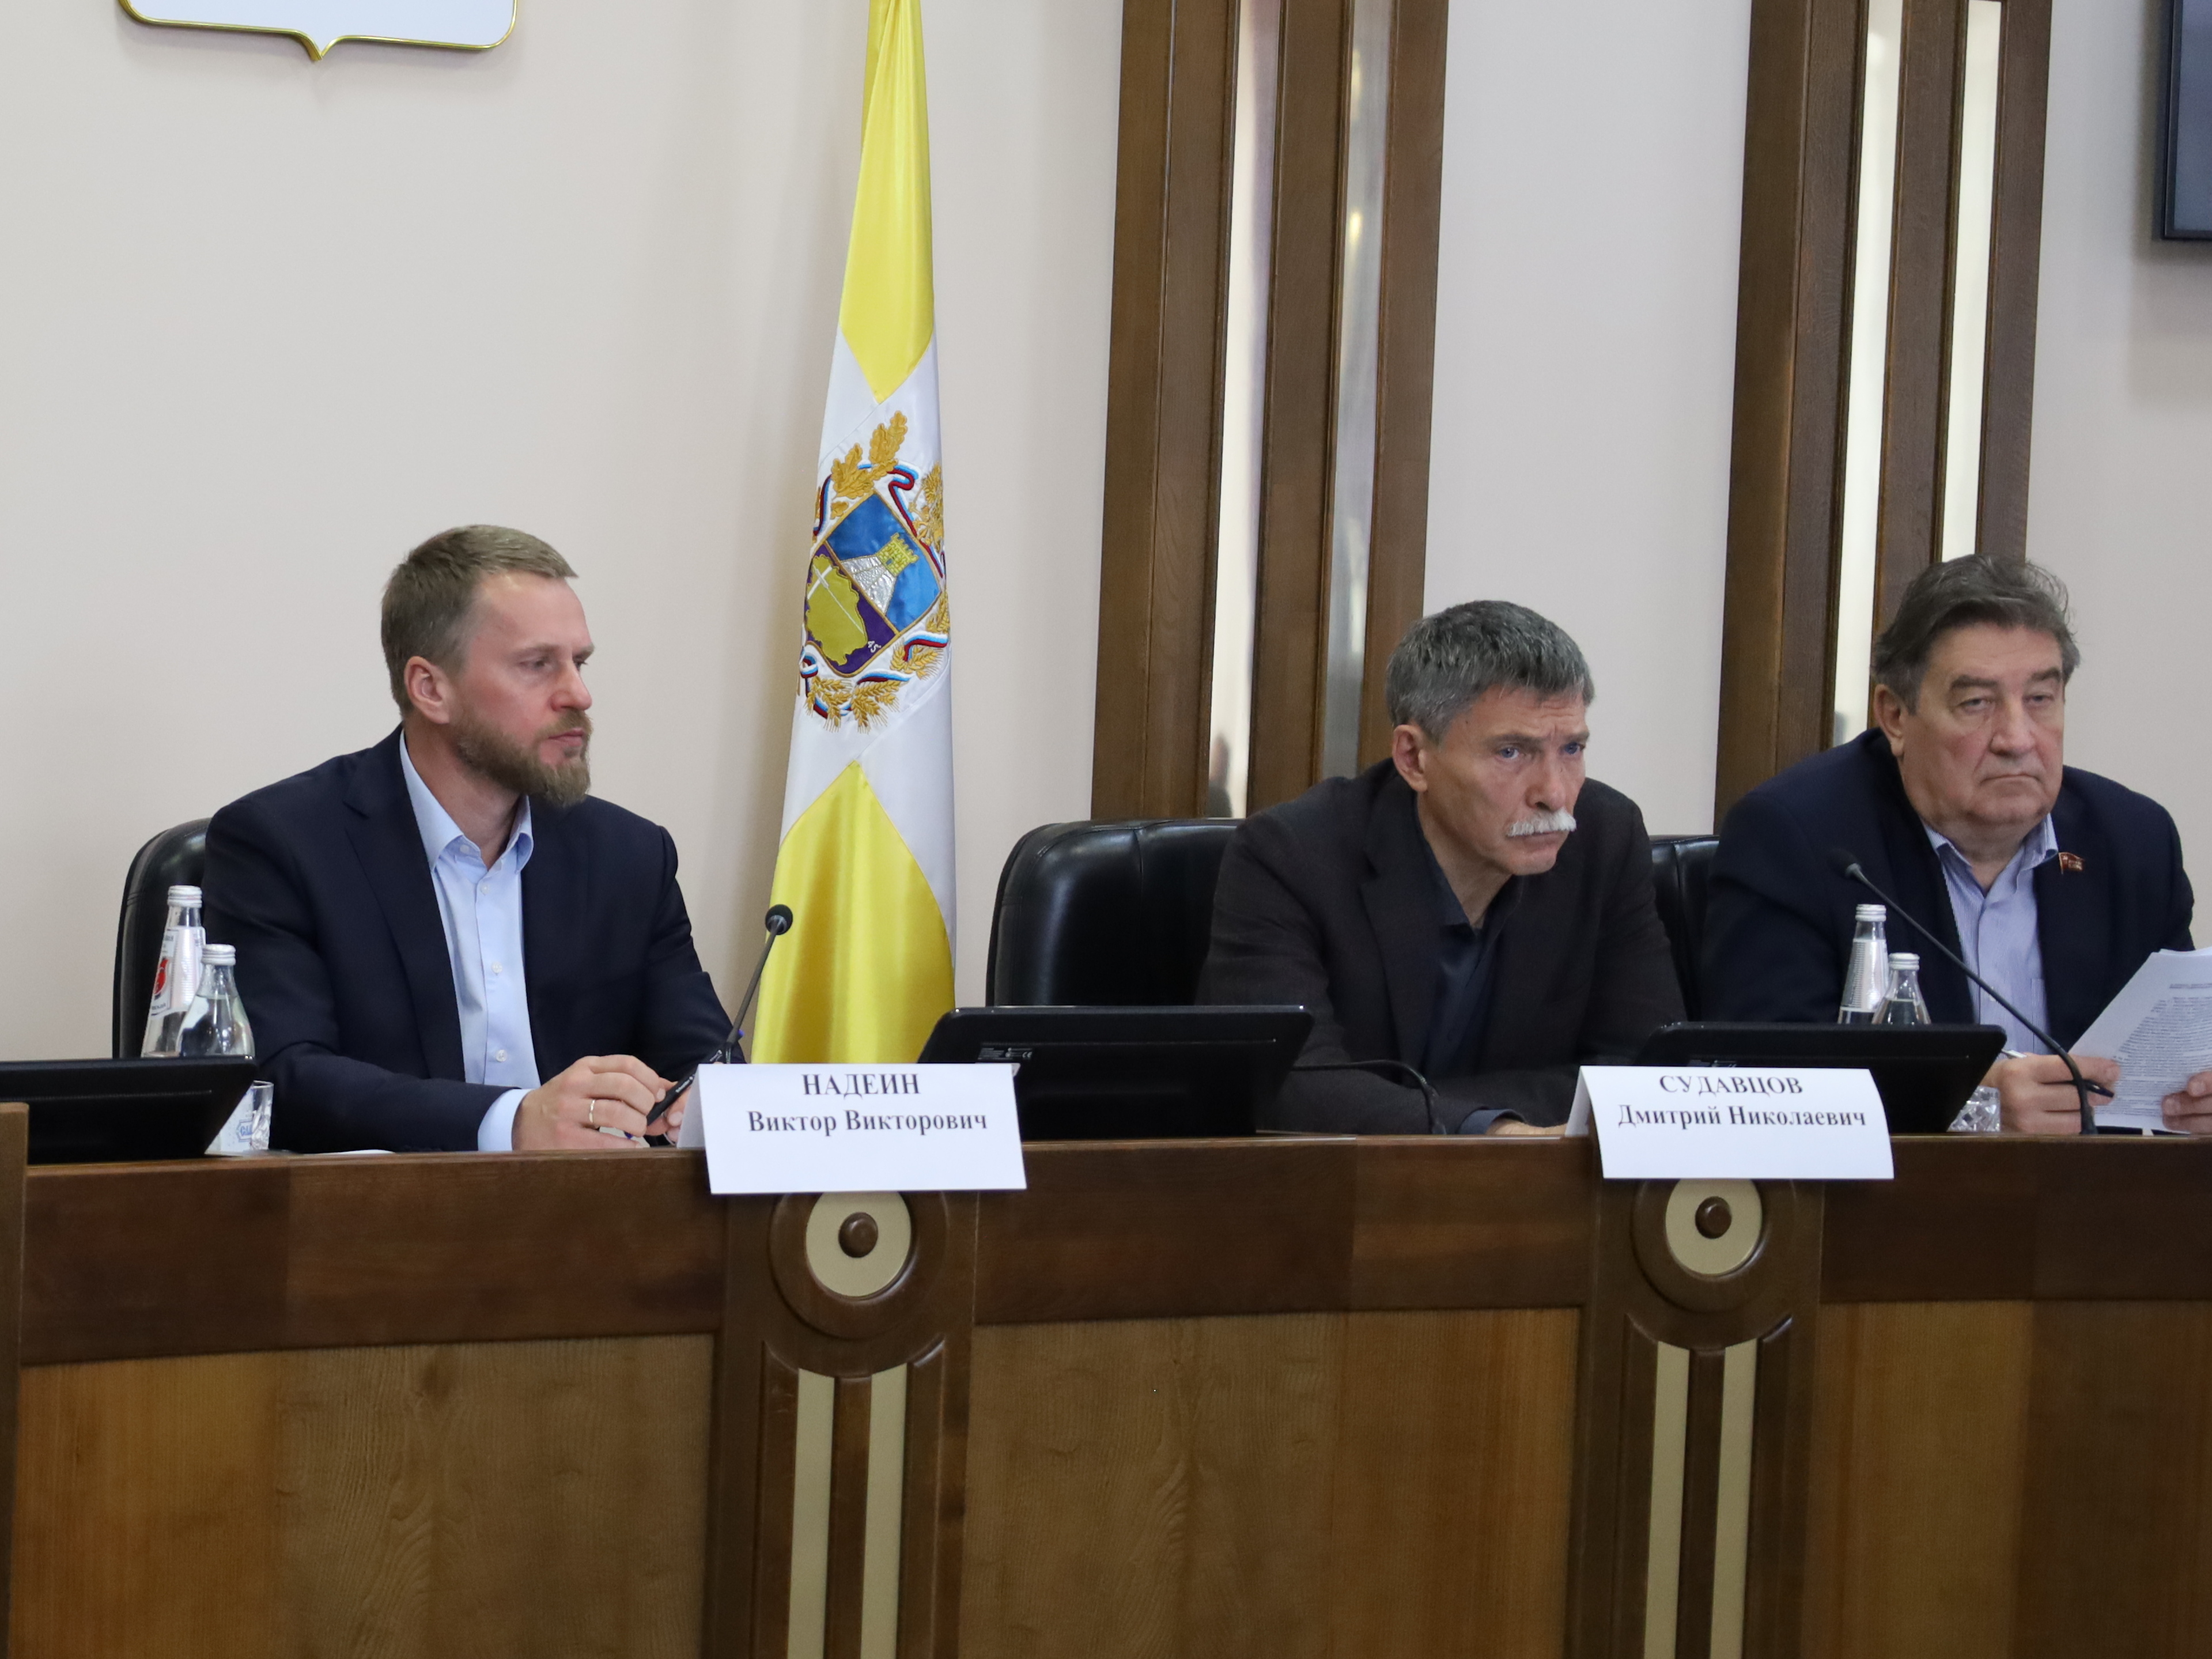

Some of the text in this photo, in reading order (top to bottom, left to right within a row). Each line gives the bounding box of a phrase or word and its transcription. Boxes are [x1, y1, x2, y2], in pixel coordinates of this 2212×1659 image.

[867, 640, 882, 653] 45
[803, 1074, 920, 1098] НАДЕИН
[1659, 1075, 1803, 1097] СУДАВЦОВ
[747, 1110, 988, 1137] Виктор Викторович
[1618, 1105, 1866, 1130] Дмитрий Николаевич
